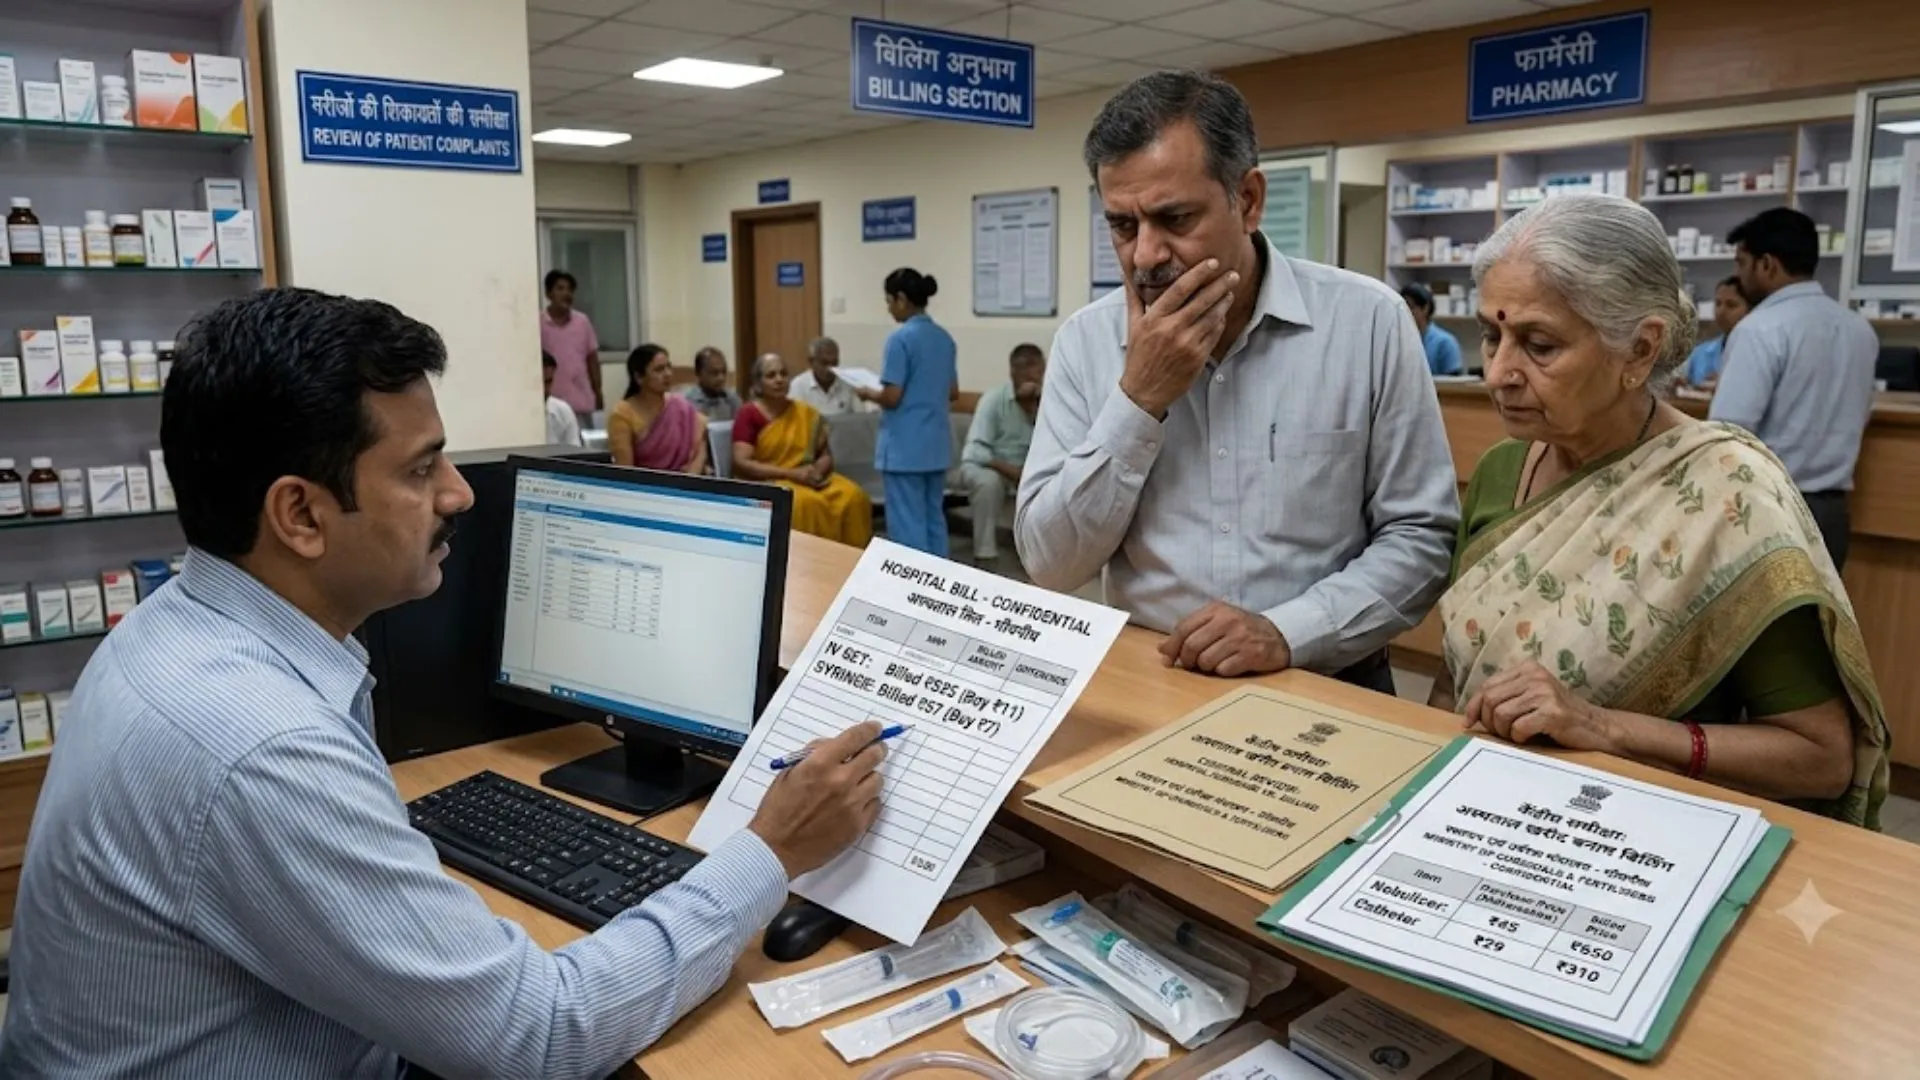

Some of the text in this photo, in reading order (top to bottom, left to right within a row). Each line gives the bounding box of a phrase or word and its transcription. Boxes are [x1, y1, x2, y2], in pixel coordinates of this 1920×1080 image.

[946, 52, 1016, 85] अनुभाग
[868, 76, 1022, 115] BILLING SECTION
[1491, 71, 1619, 108] PHARMACY
[359, 92, 378, 120] की
[446, 100, 463, 127] की
[313, 127, 362, 147] REVIEW
[365, 131, 381, 148] OF
[386, 132, 434, 151] PATIENT
[880, 559, 946, 592] HOSPITAL
[949, 581, 979, 602] BILL
[1473, 934, 1506, 952] ₹29
[1555, 959, 1600, 983] ₹310
